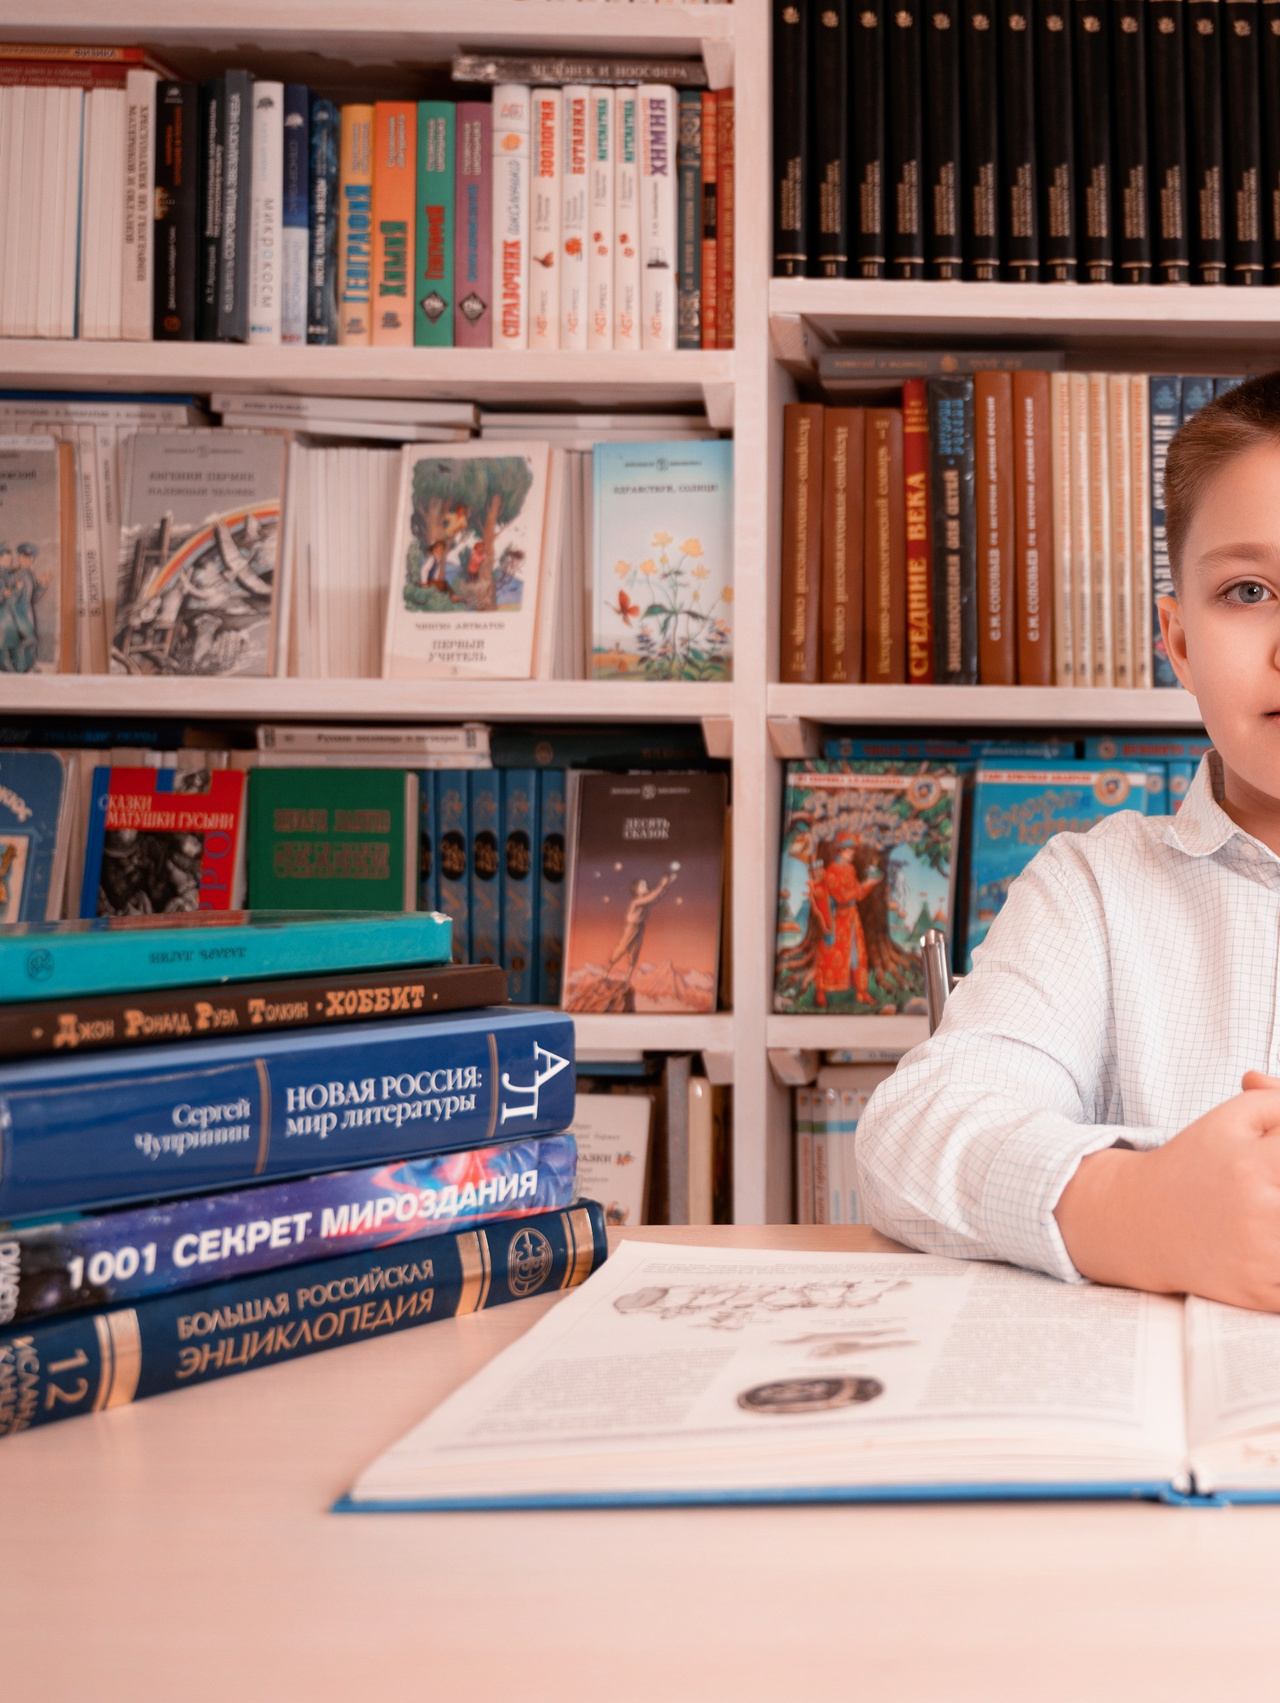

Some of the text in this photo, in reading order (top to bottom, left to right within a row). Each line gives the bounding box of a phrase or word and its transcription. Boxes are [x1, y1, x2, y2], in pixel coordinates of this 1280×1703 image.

[540, 99, 555, 178] ЗООЛОГИЯ
[571, 97, 586, 176] БОТАНИКА
[649, 97, 668, 177] ХИМИЯ
[502, 239, 521, 339] СПРАВОЧНИК
[905, 472, 931, 678] СРЕДНИЕ ВЕКА
[428, 651, 487, 663] УЧИТЕЛЬ
[432, 639, 486, 651] ПЕРВЫЙ
[98, 794, 153, 812] СКАЗКИ
[105, 811, 235, 830] МАТУШКИ ГУСЫНИ
[625, 817, 671, 830] ДЕСЯТЬ
[623, 829, 670, 840] СКАЗОК
[124, 1008, 192, 1037] Рональд
[195, 1000, 239, 1032] Руэл
[247, 998, 309, 1025] Толкин
[325, 983, 426, 1017] ХОББИТ
[171, 1097, 252, 1130] Сергей
[285, 1065, 485, 1114] НОВАЯ РОССИЯ:
[285, 1092, 478, 1140] мир литературы
[133, 1122, 251, 1160] Чупринин
[575, 1152, 612, 1164] КАЗКИ
[66, 1239, 158, 1289] 1001
[171, 1211, 313, 1268] СЕКРЕТ
[319, 1168, 539, 1239] МИРОЗДАНИЯ
[176, 1255, 436, 1341] БОЛЬШАЯ РОССИЙСКАЯ
[175, 1285, 437, 1381] ЭНЦИКЛОПЕДИЯ
[46, 1348, 89, 1410] 12
